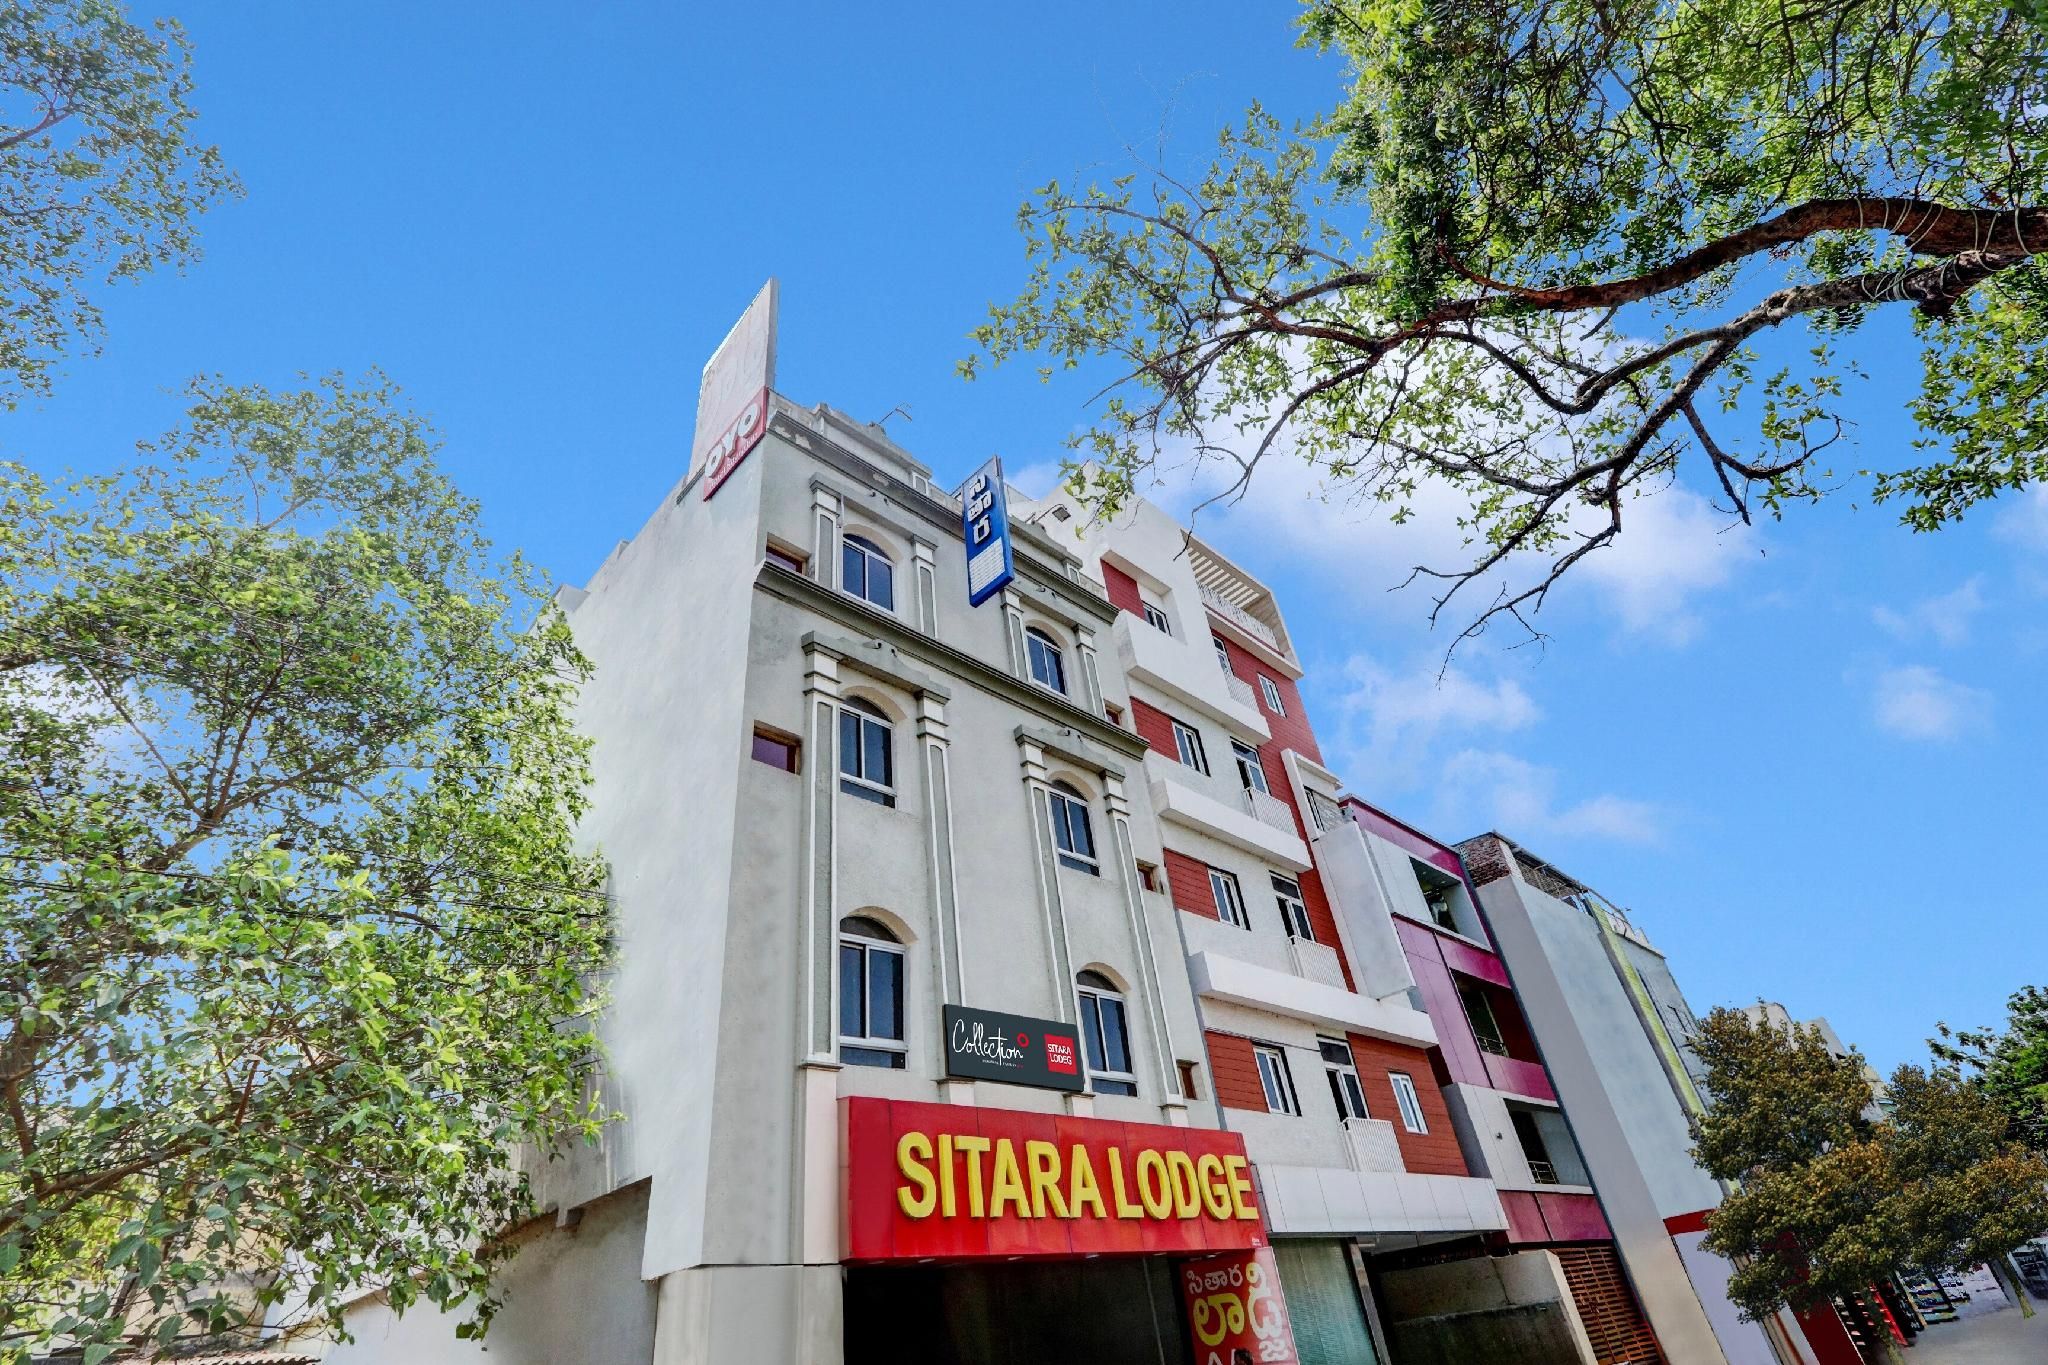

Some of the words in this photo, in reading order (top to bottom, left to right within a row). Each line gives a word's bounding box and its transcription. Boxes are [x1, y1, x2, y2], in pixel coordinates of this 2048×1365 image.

[704, 403, 761, 479] OYO
[952, 1018, 1023, 1066] Collection
[1047, 1043, 1072, 1056] SITARA
[896, 1131, 1108, 1220] SITARA
[1107, 1146, 1260, 1221] LODGE
[1186, 1263, 1244, 1295] సితార
